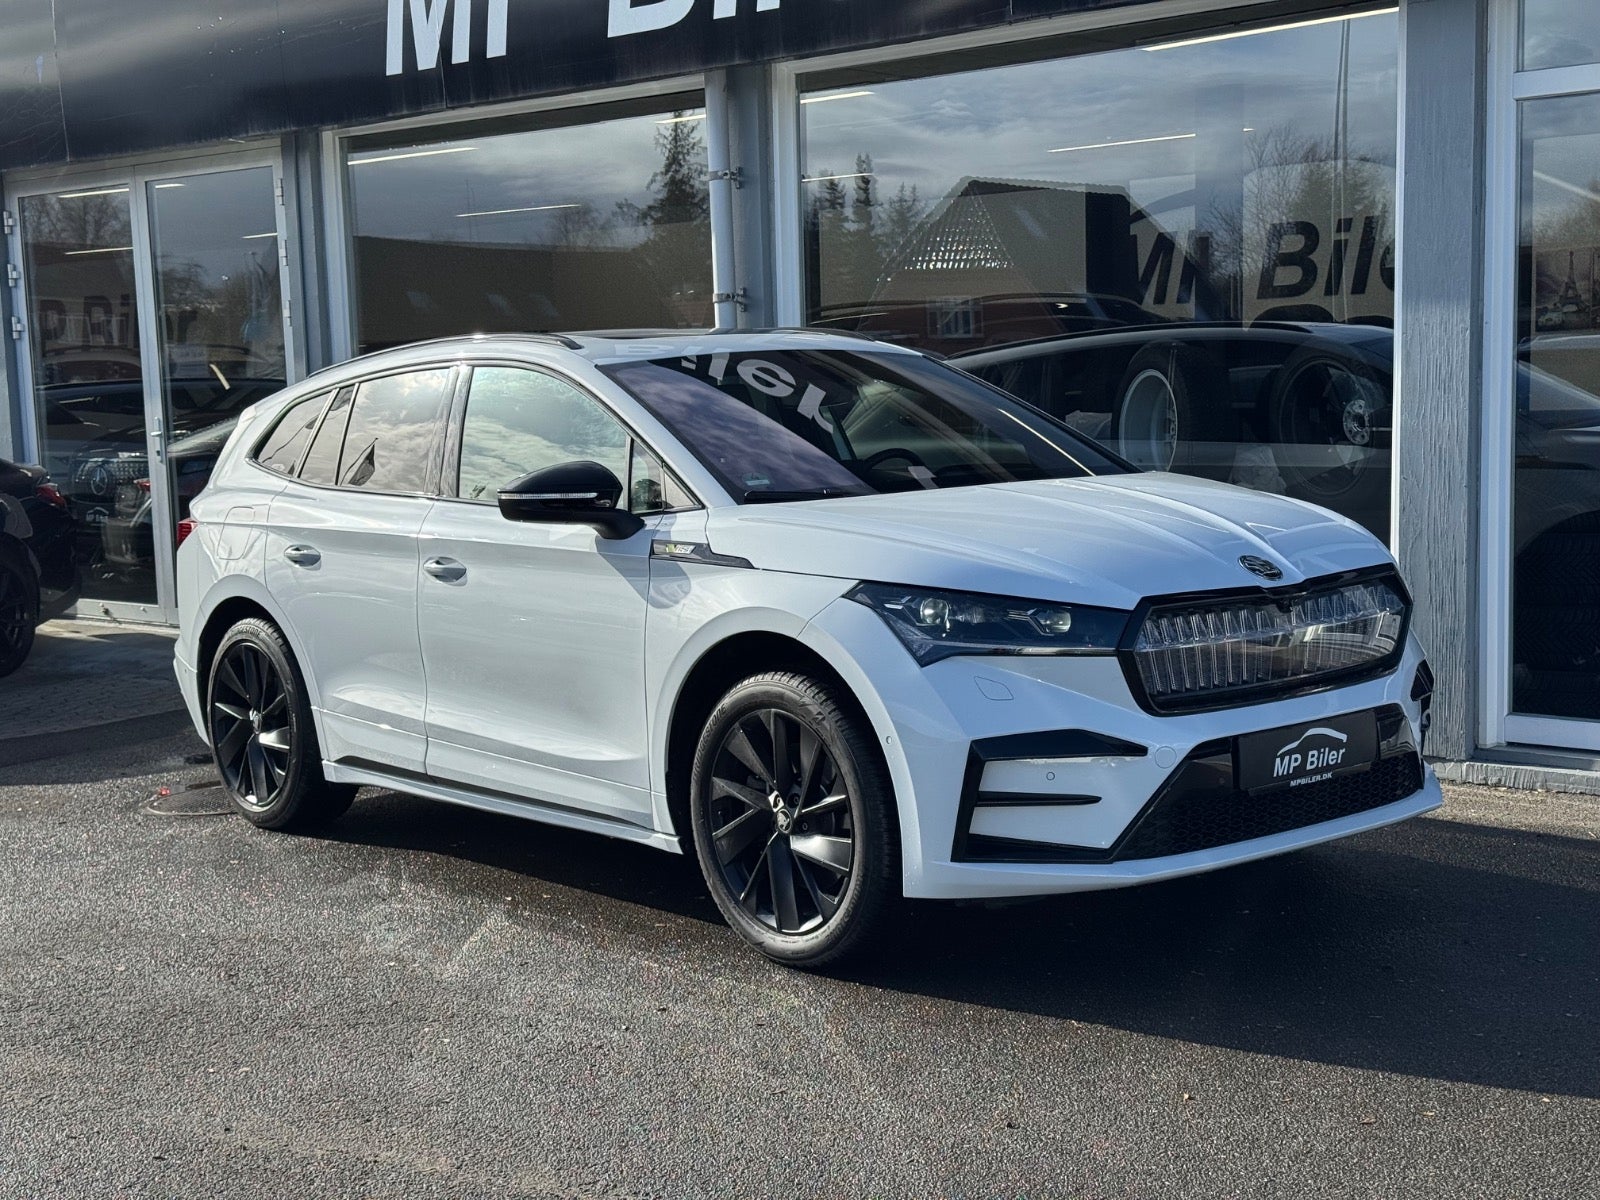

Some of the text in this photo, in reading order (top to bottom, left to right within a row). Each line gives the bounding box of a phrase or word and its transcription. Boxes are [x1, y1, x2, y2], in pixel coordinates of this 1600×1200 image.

[1273, 747, 1346, 777] MP Biler
[1289, 772, 1333, 787] MPBILER.DK
